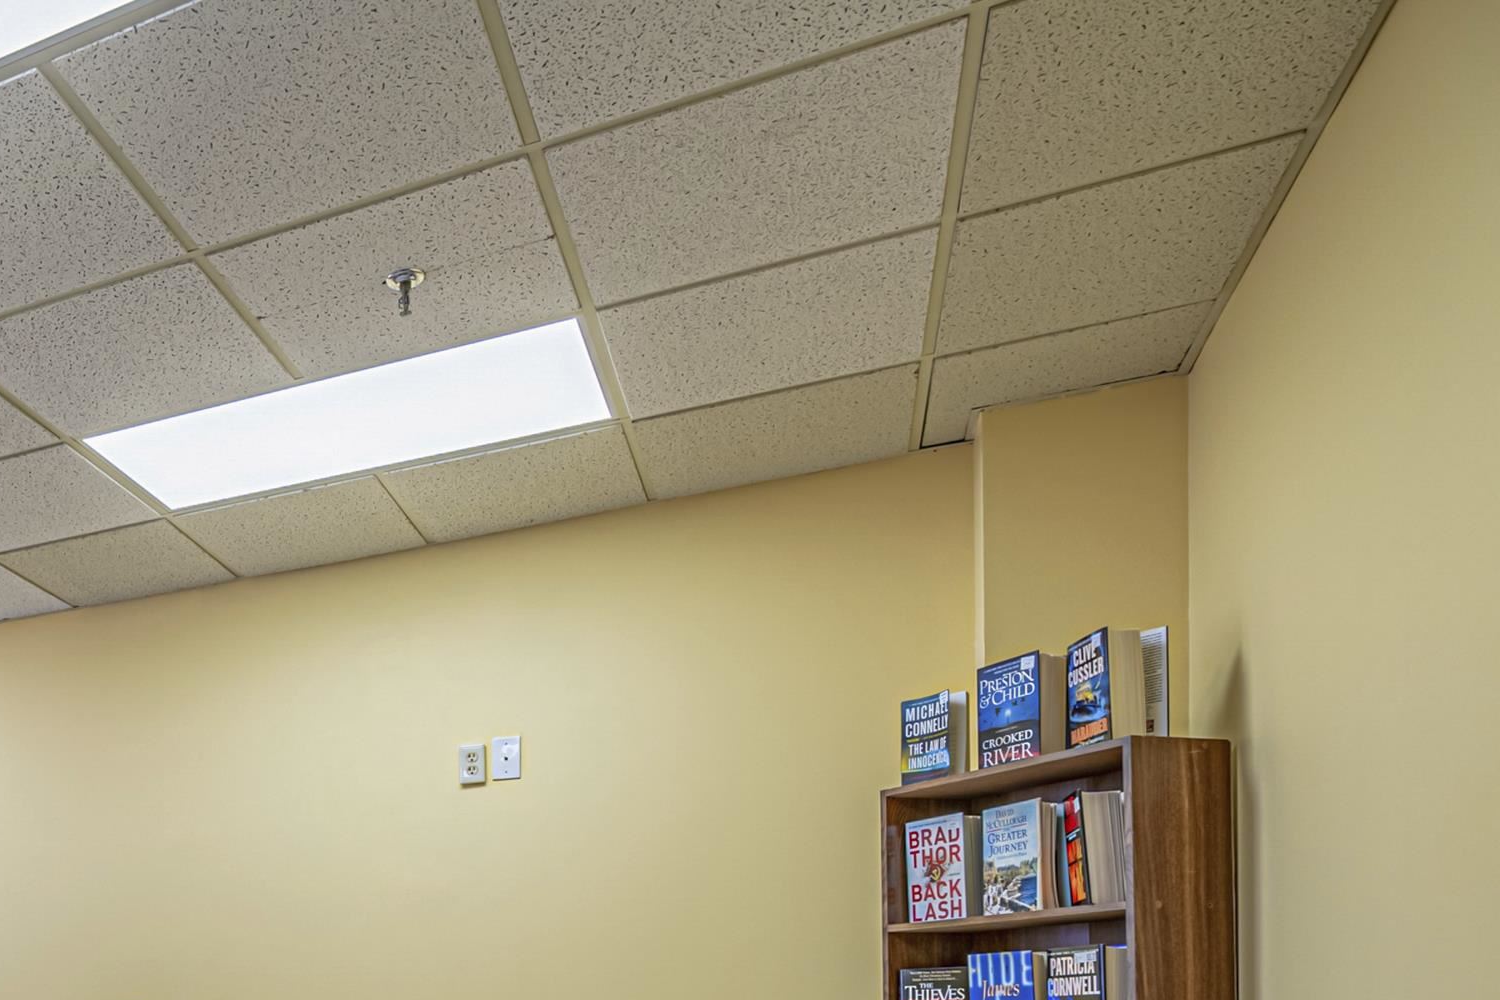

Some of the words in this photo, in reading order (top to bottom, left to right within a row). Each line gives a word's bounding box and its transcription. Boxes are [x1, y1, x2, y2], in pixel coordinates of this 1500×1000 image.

[1073, 643, 1097, 667] CLIVE
[980, 669, 1035, 695] PRESTON
[1068, 656, 1104, 688] CUSSLER
[991, 682, 1035, 705] CHILD
[905, 700, 949, 722] MICHAEL
[905, 714, 949, 738] CONNELLY
[908, 742, 924, 757] THE
[925, 739, 939, 754] LAW
[982, 729, 1034, 750] CROOKED
[983, 742, 1034, 768] RIVER
[909, 826, 960, 849] BRAD
[987, 829, 1028, 845] GREATER
[988, 840, 1029, 857] JOURNEY
[910, 844, 961, 868] THOR
[911, 878, 961, 902] BACK
[912, 898, 962, 922] LASH
[969, 951, 1033, 988] HIDE
[1048, 975, 1101, 997] CORNWELL
